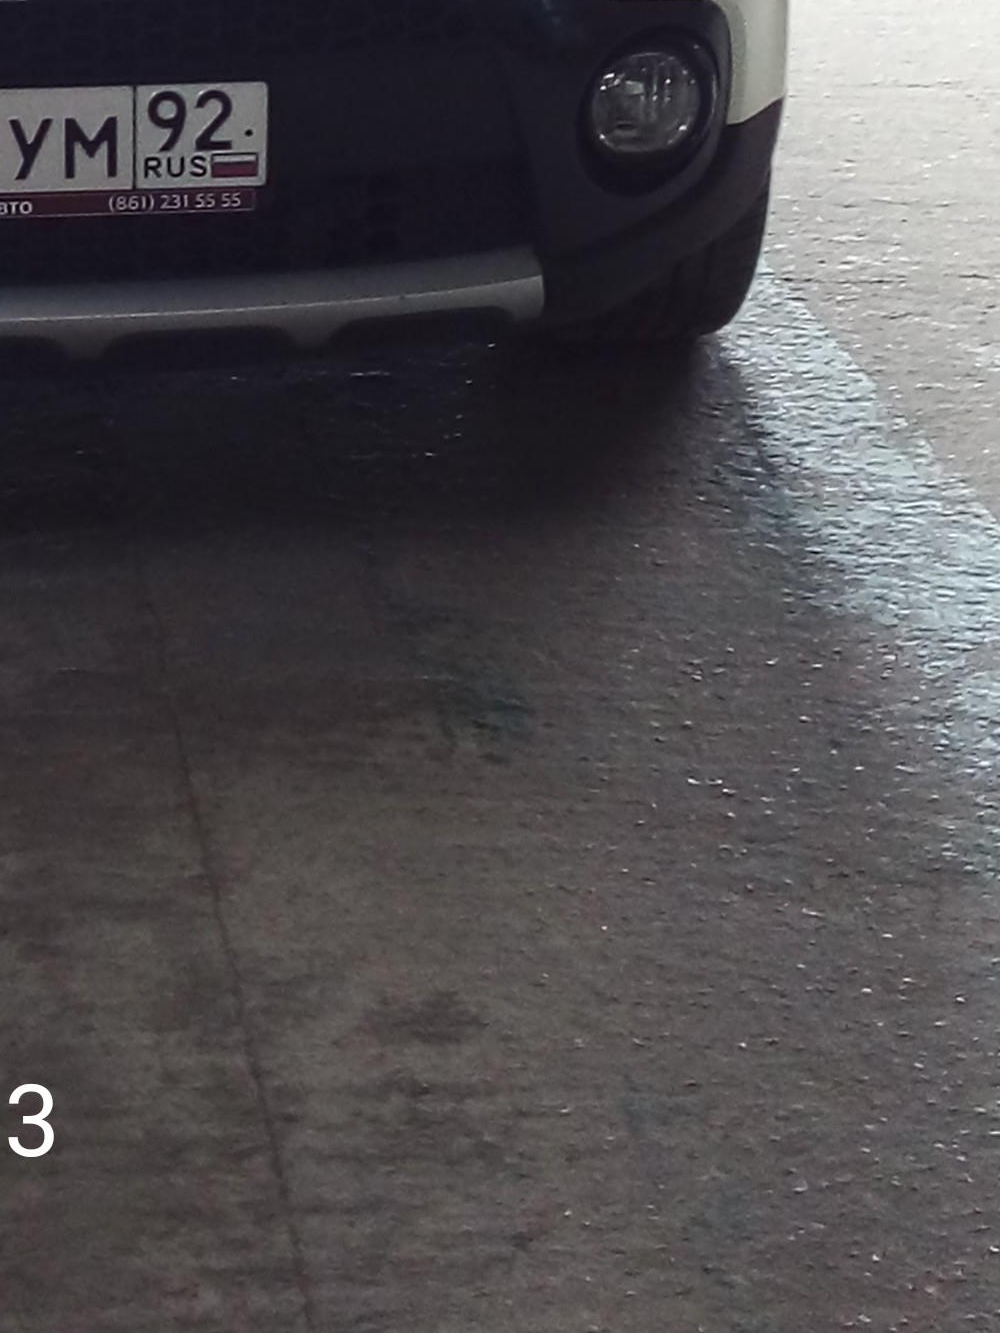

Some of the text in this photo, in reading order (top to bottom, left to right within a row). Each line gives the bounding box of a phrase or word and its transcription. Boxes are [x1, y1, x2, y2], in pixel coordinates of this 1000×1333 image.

[147, 89, 233, 152] 92
[143, 155, 208, 178] RUS
[108, 192, 241, 212] (861) 231 55 55
